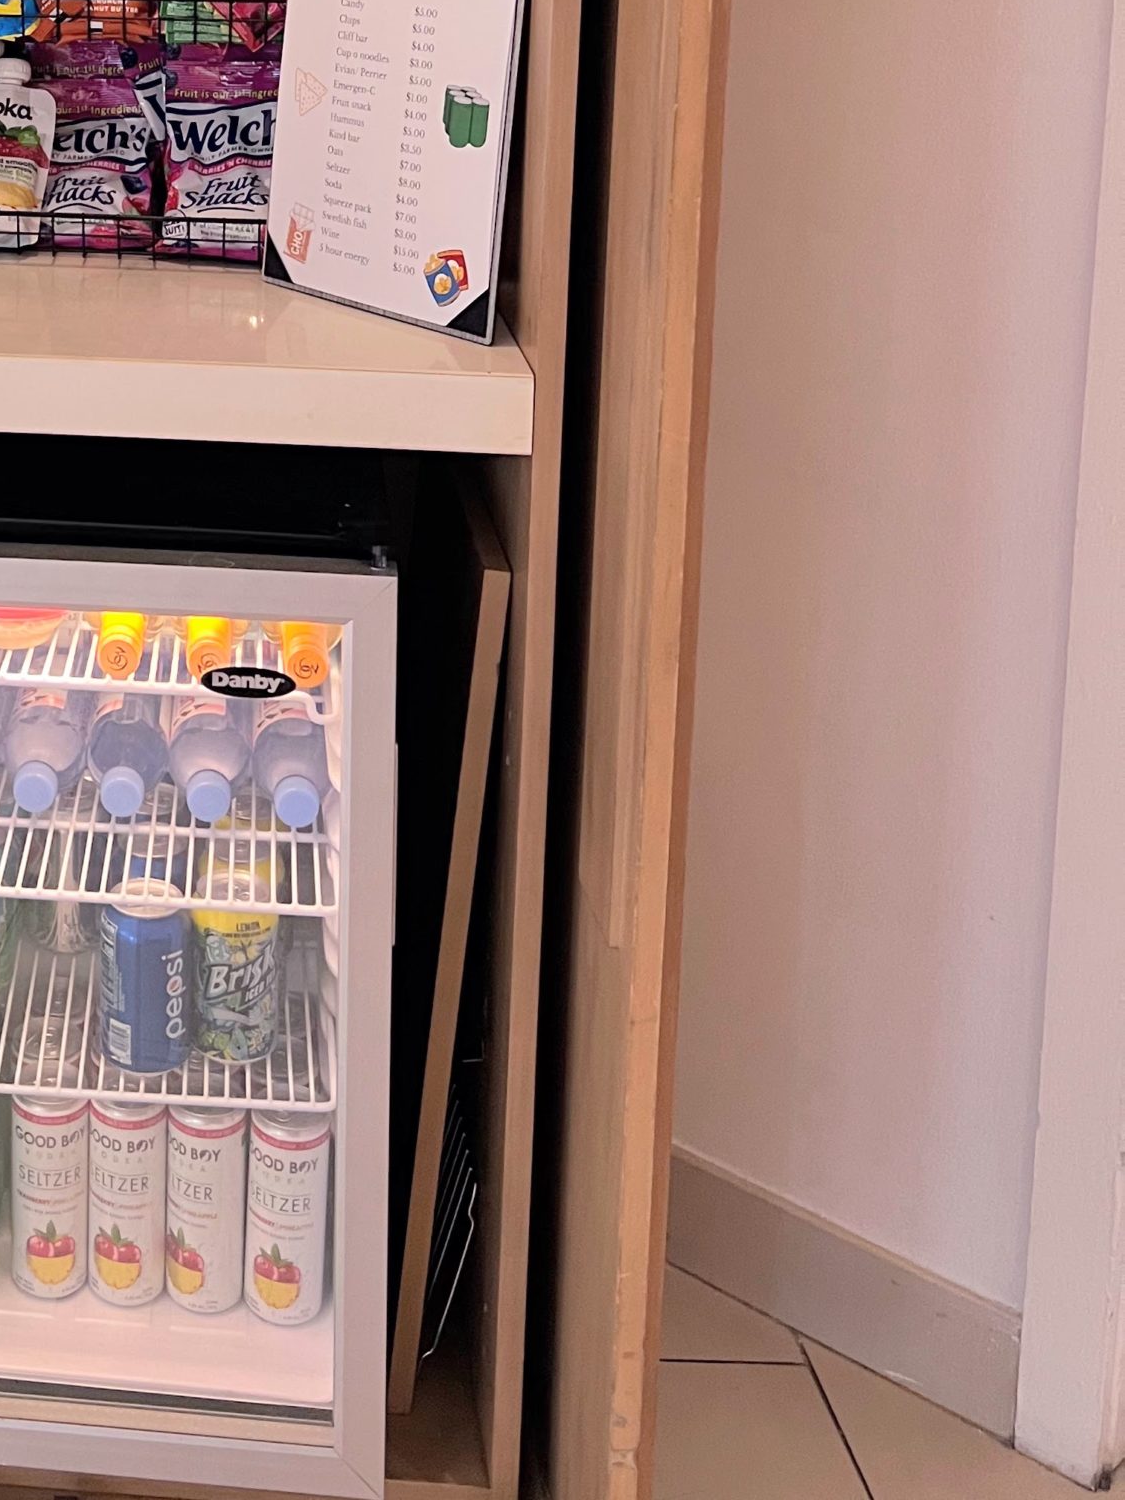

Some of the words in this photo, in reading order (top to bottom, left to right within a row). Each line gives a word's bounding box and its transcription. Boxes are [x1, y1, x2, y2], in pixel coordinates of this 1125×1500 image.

[337, 30, 355, 42] Cliff
[355, 32, 368, 43] bar
[336, 47, 352, 60] Cup
[360, 52, 390, 63] noodles
[175, 89, 198, 99] Fruit
[201, 89, 209, 99] is
[333, 79, 377, 96] Emergen-C
[331, 95, 350, 108] Fruit
[351, 100, 372, 112] snack
[53, 122, 147, 154] elch's
[168, 109, 276, 154] Welch
[328, 128, 347, 141] Kind
[347, 131, 361, 143] bar
[325, 161, 351, 175] Seltzer
[399, 159, 422, 172] $7.00
[51, 174, 107, 194] Fruit
[204, 172, 262, 195] Fruit
[324, 178, 343, 190] Soda
[43, 185, 116, 206] nacks
[181, 188, 270, 209] Snacks
[323, 194, 353, 209] Squeeze
[354, 203, 372, 214] pack
[322, 210, 352, 226] Swedish
[353, 217, 368, 229] fish
[395, 211, 417, 224] $7.00
[320, 226, 340, 239] Wine
[325, 244, 343, 257] hour
[344, 250, 370, 266] energy
[212, 671, 281, 694] Danby
[161, 950, 186, 1039] pepsi
[15, 1125, 57, 1148] GOOD
[90, 1128, 122, 1152] OOD
[127, 1136, 155, 1154] BOY
[190, 1148, 221, 1163] BOY
[18, 1164, 81, 1188] SELTZER
[289, 1158, 319, 1175] BOY
[171, 1176, 213, 1201] LTZER
